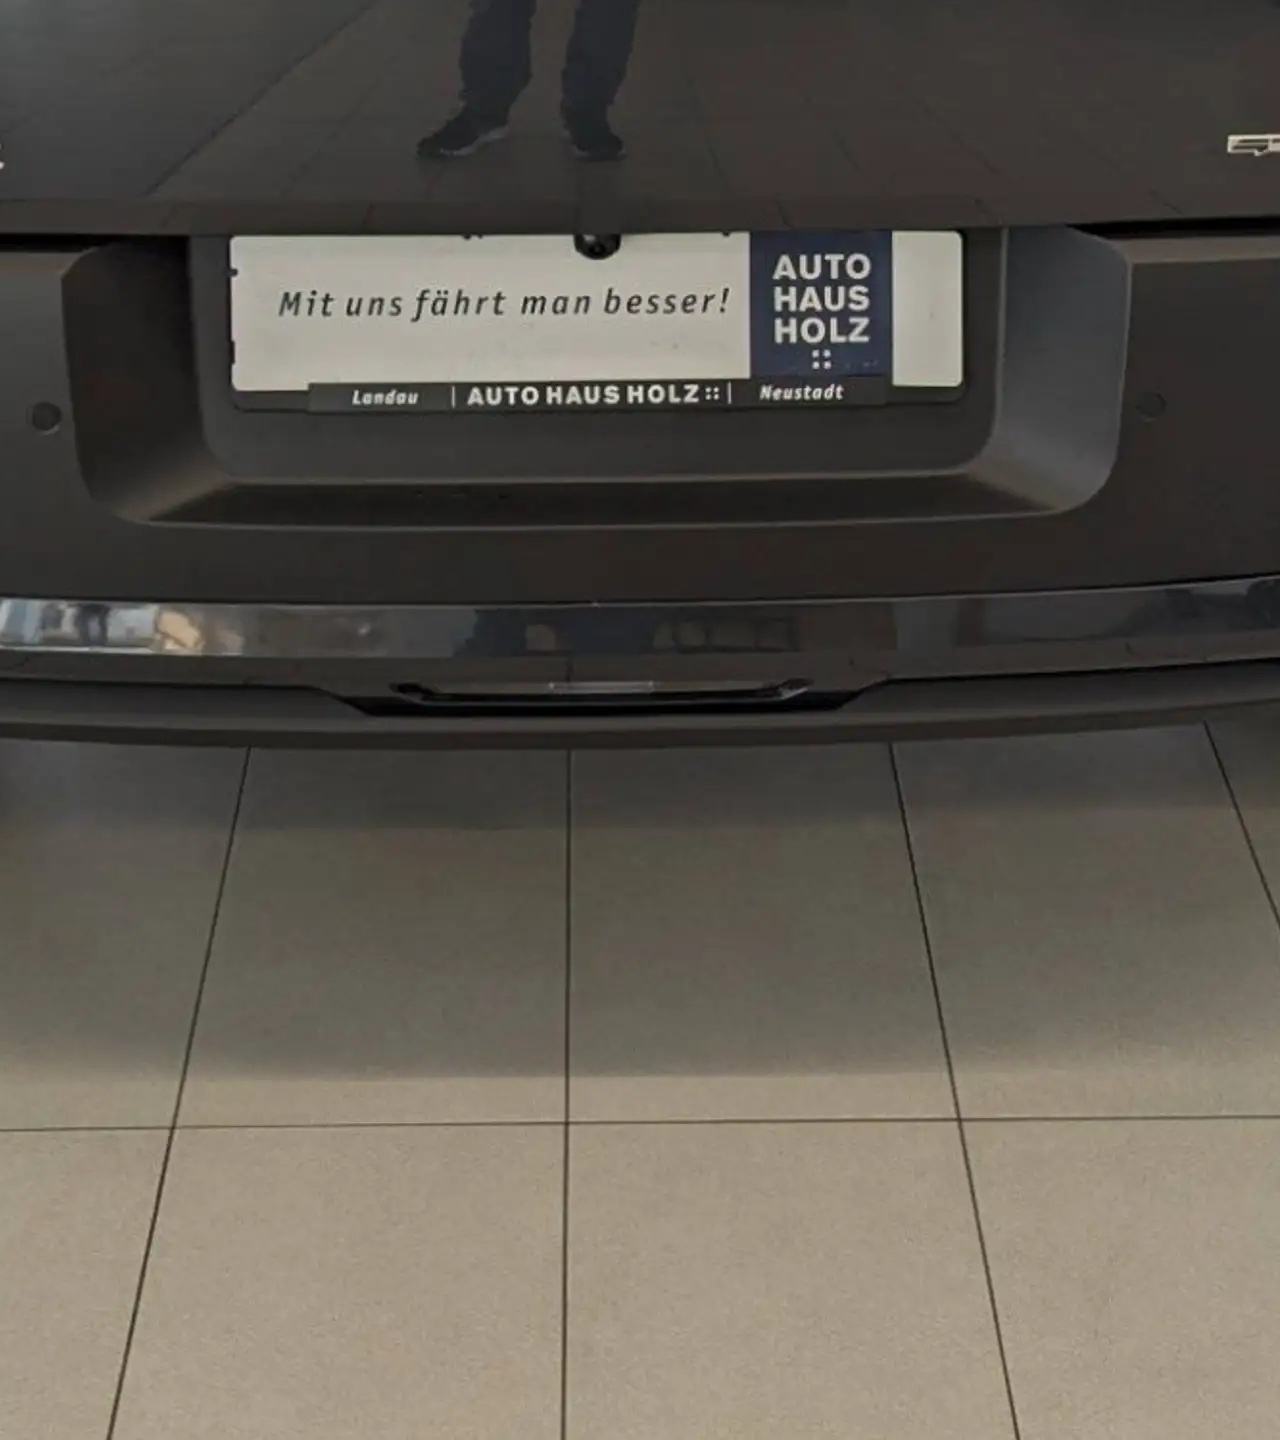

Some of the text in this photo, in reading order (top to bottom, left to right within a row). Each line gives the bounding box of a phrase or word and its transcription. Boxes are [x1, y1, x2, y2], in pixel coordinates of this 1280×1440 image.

[771, 252, 872, 280] AUTO
[277, 287, 731, 323] Mit uns fährt man besser!
[773, 284, 871, 312] HAUS
[773, 316, 871, 344] HOLZ
[351, 388, 419, 406] Landau
[626, 383, 701, 405] HOLZ
[758, 383, 845, 402] Neustadt
